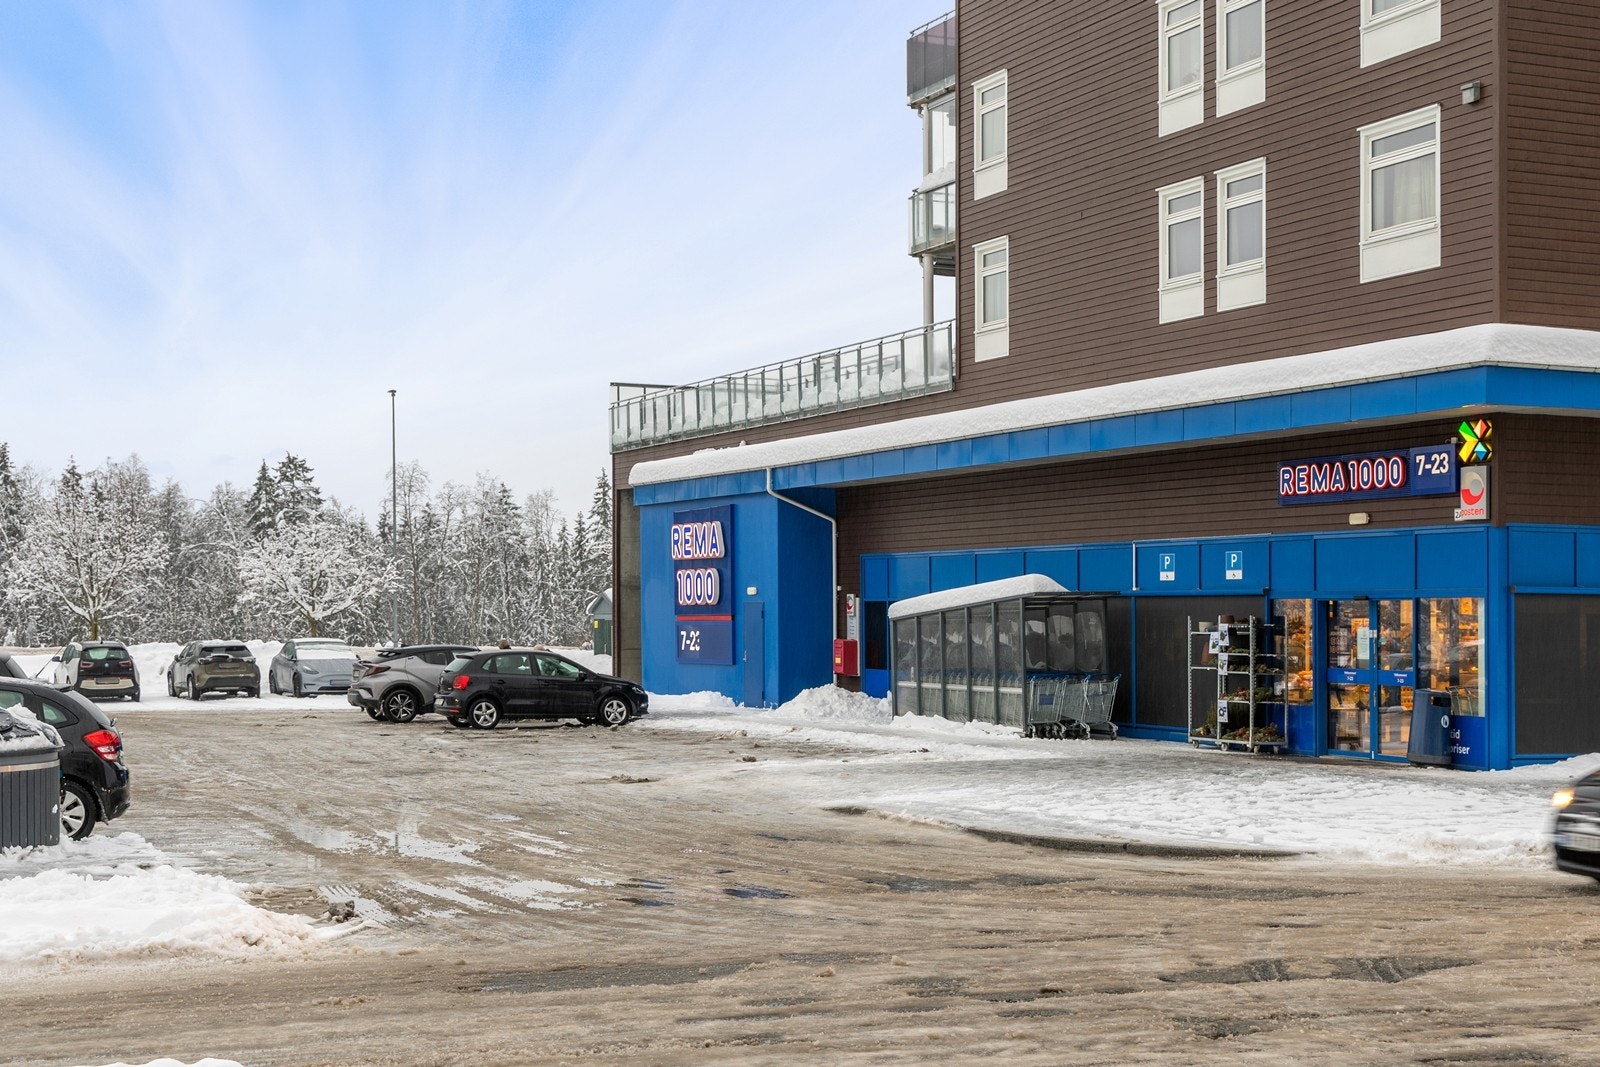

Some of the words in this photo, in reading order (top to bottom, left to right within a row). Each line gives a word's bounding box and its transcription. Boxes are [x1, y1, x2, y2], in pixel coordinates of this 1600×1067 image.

[1279, 462, 1347, 496] REMA
[1348, 456, 1405, 490] 1000
[1415, 452, 1450, 476] 7-23
[671, 520, 724, 560] REMA
[1164, 556, 1171, 569] P
[1231, 553, 1238, 567] P
[676, 567, 719, 606] 1000
